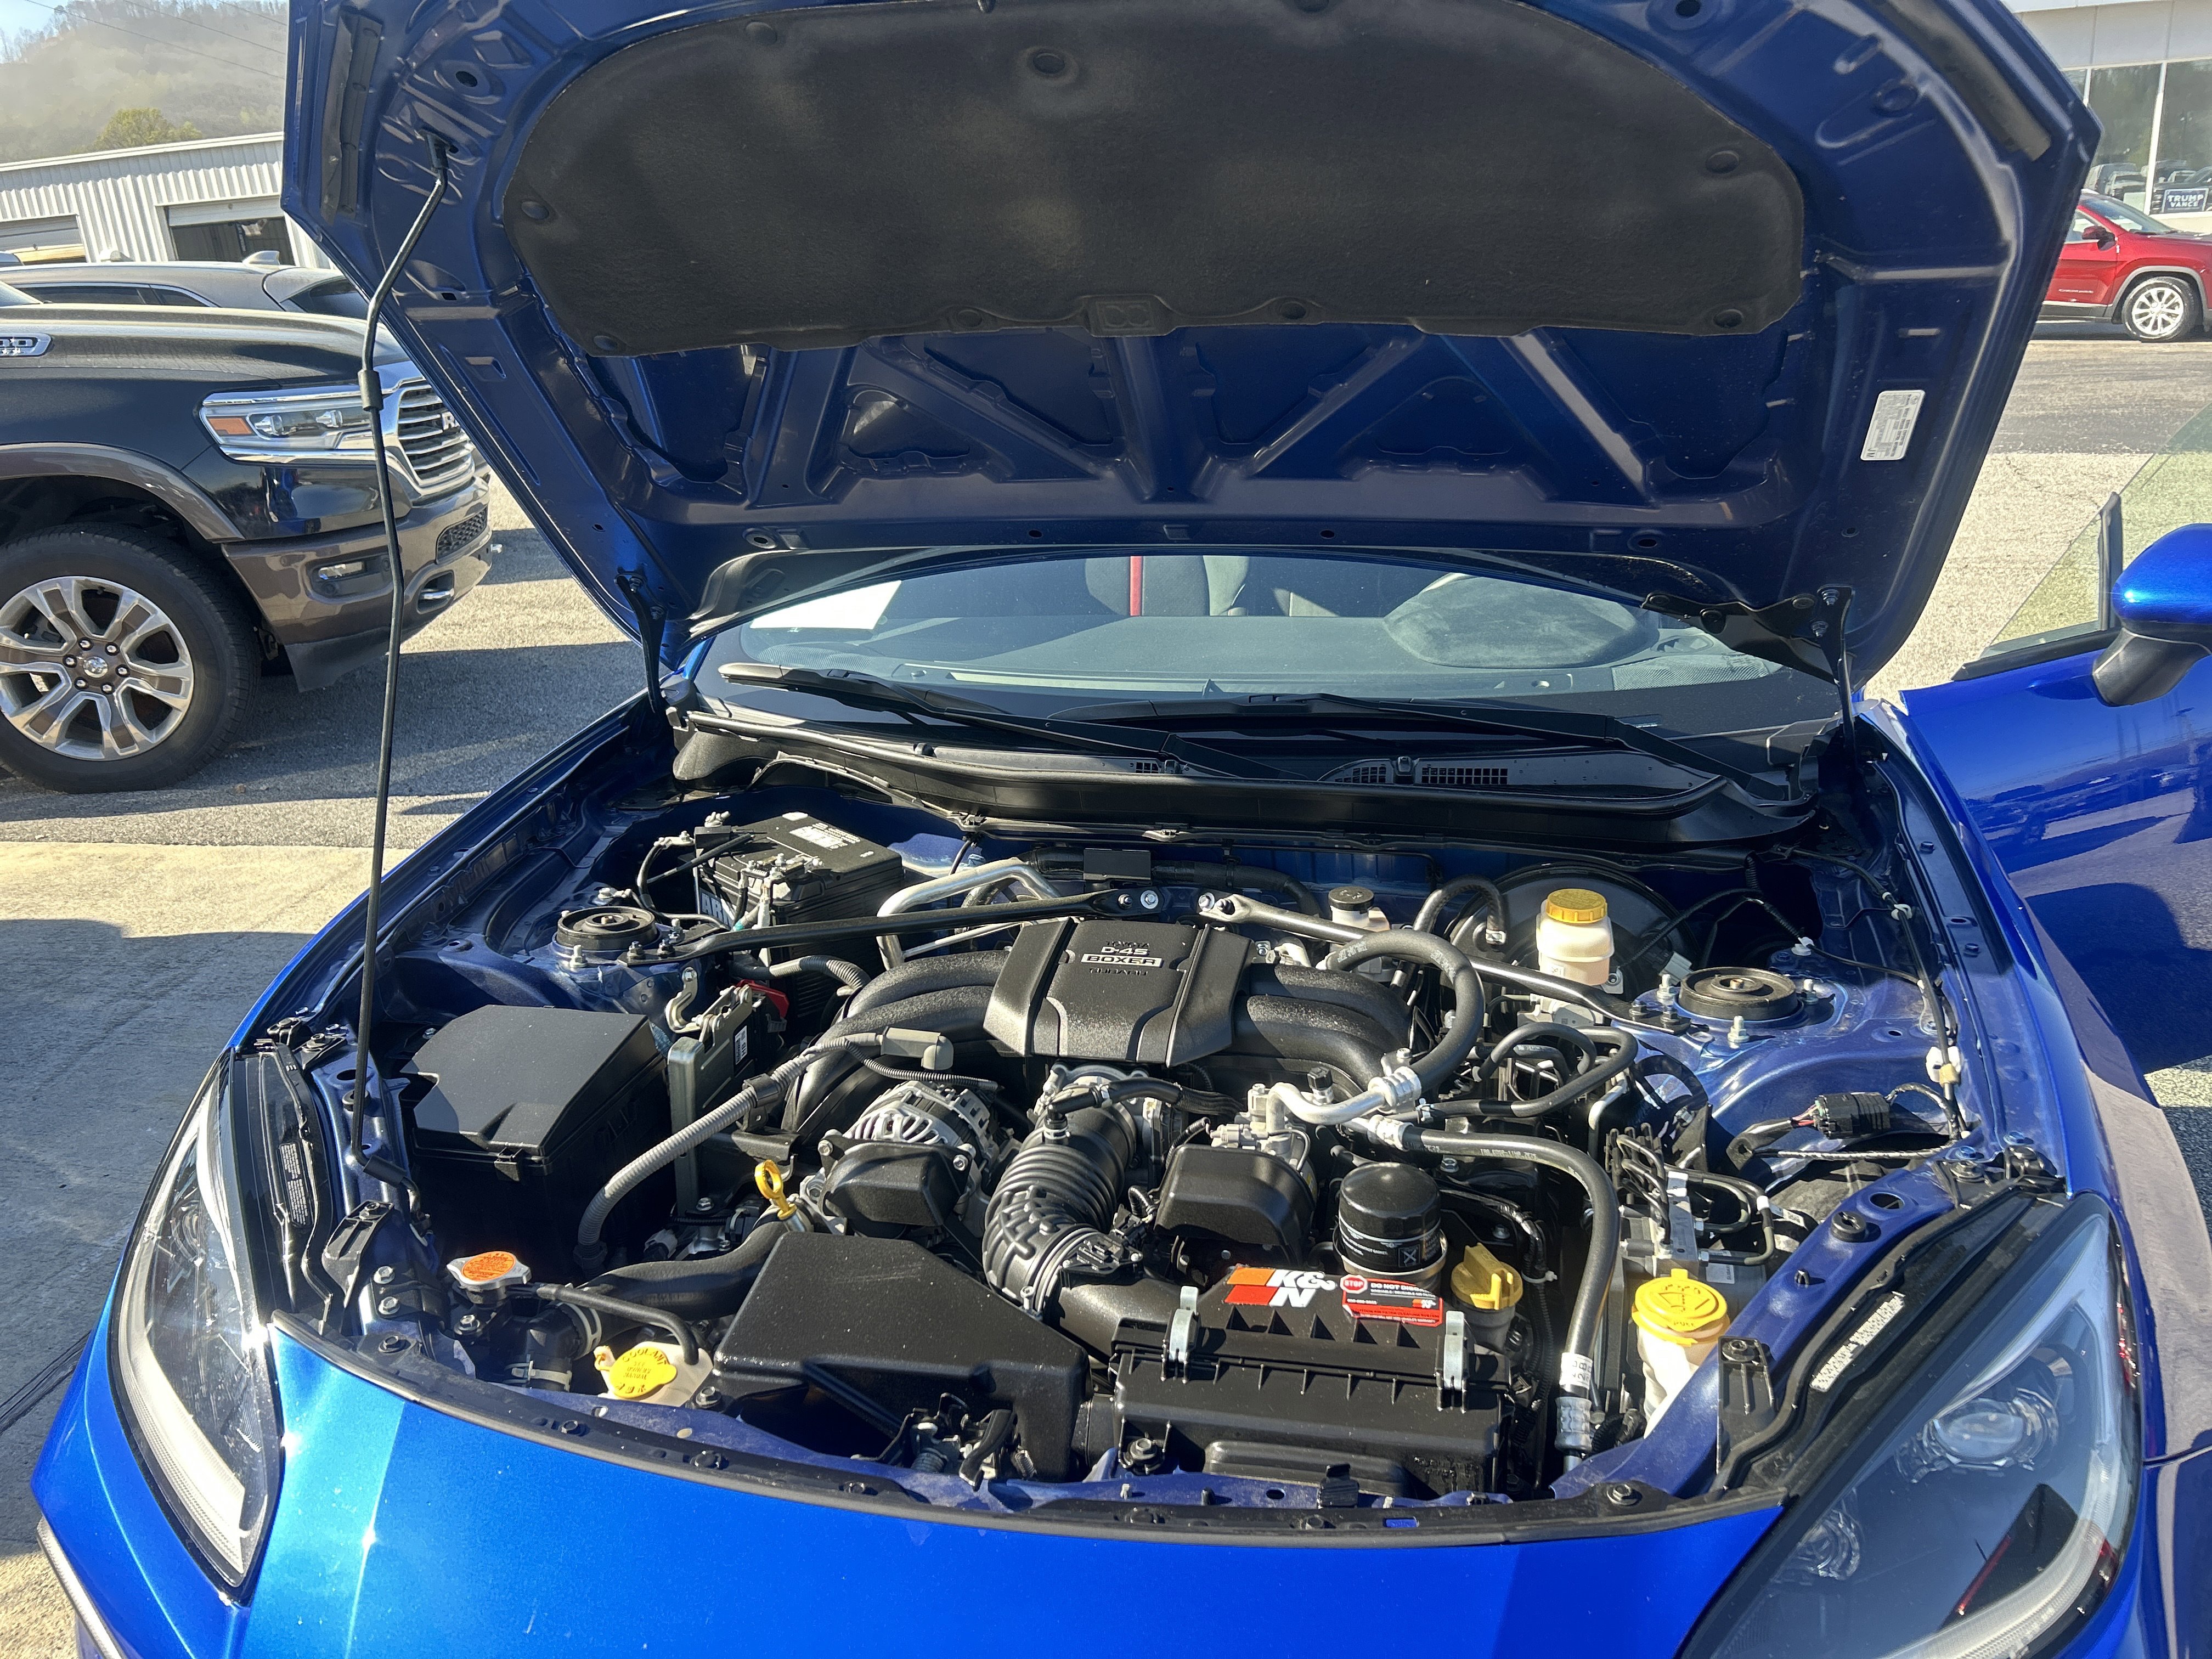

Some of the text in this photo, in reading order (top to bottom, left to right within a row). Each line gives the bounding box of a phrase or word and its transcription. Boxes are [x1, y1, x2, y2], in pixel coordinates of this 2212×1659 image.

[1101, 946, 1148, 955] D-4S
[1087, 955, 1155, 965] BOXER
[1090, 967, 1148, 975] SUBARU
[622, 1348, 667, 1365] COOLANT
